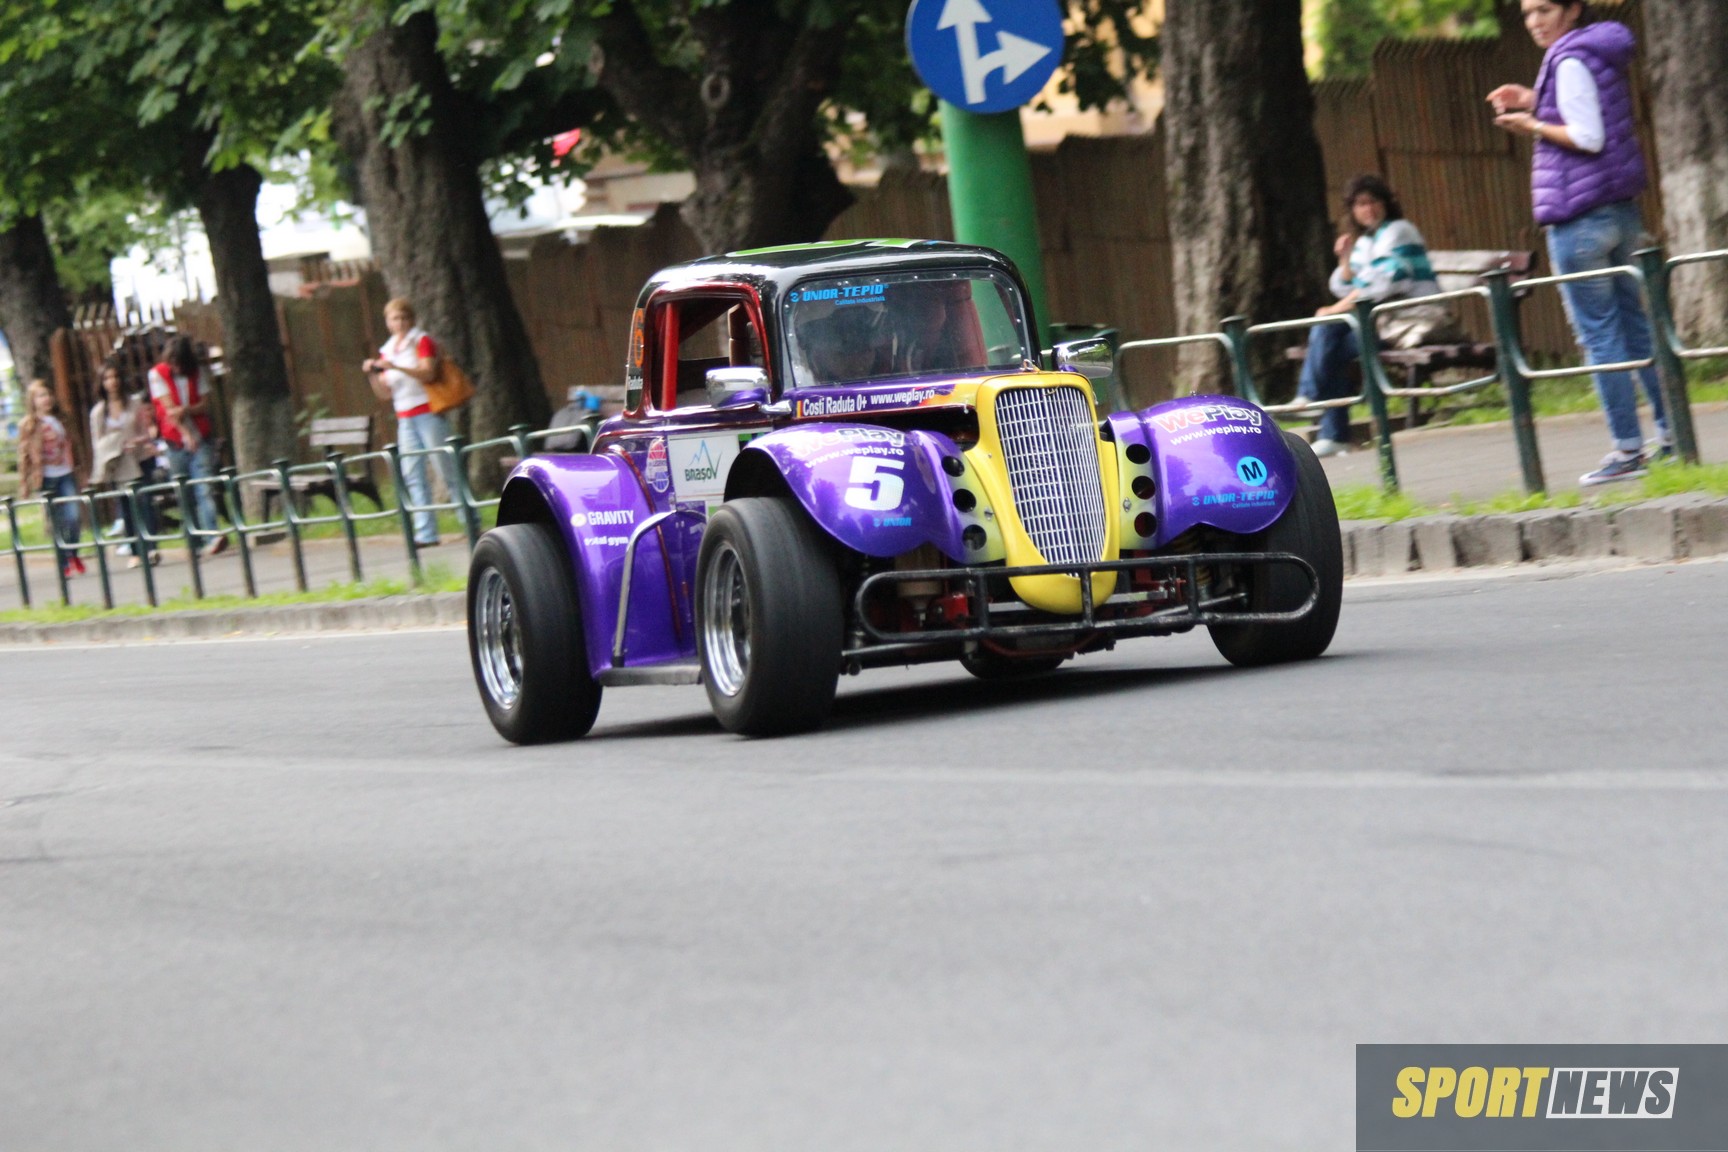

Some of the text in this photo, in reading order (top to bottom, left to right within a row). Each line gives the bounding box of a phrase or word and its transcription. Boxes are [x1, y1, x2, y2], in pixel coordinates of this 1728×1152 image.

[803, 398, 825, 417] Costi
[826, 396, 855, 414] Raduta
[870, 389, 935, 405] www.weplay.ro
[1169, 424, 1262, 446] www.weplay.ro
[804, 445, 905, 468] www.weplay.ro
[1241, 461, 1263, 481] M
[844, 455, 905, 511] 5
[587, 509, 635, 526] GRAVITY
